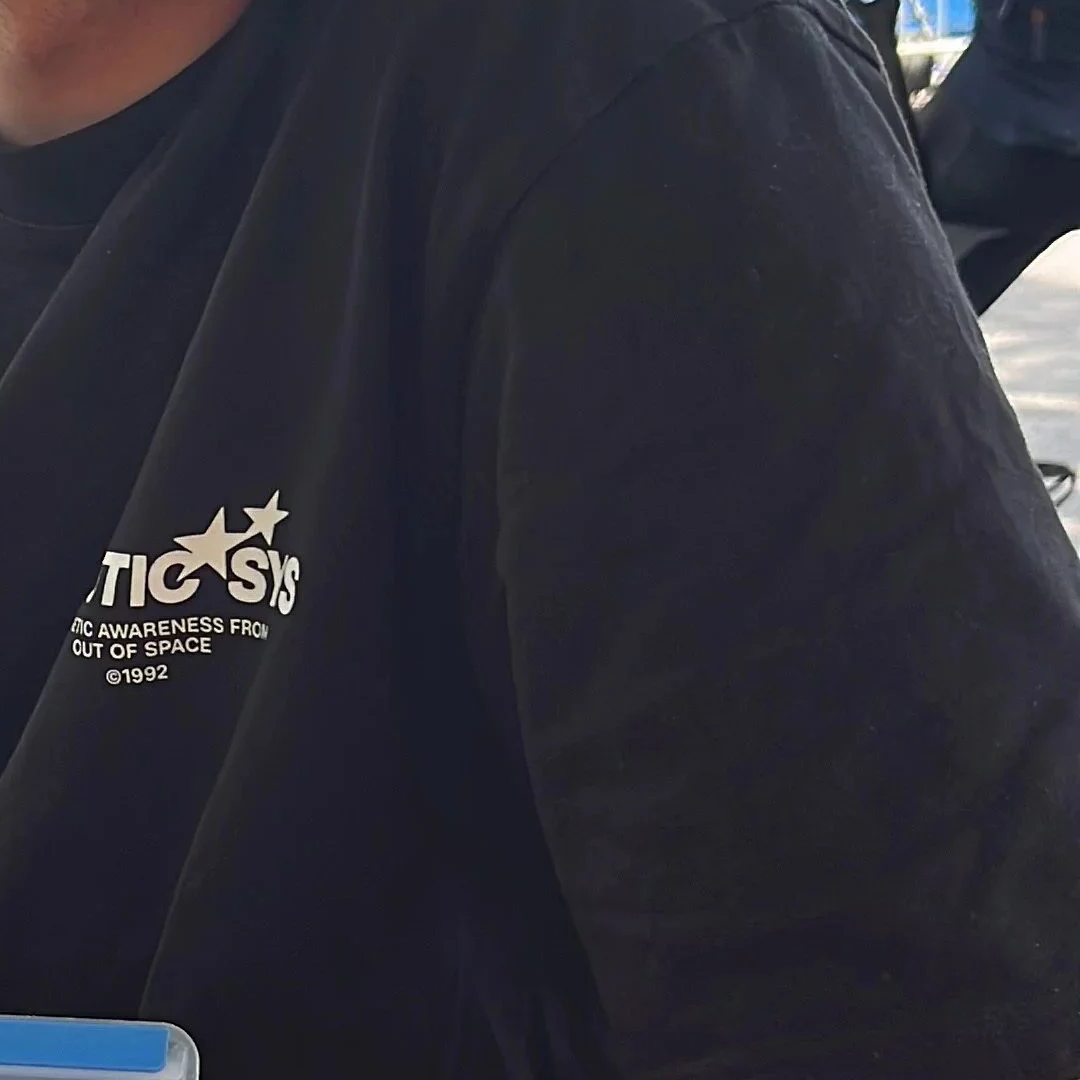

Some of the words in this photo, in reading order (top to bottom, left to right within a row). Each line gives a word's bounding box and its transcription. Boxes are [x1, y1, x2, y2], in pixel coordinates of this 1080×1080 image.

[85, 550, 201, 607] TIC
[97, 616, 225, 639] AWARENESS
[72, 639, 104, 659] OUT
[109, 643, 138, 659] OF
[144, 637, 212, 657] SPACE
